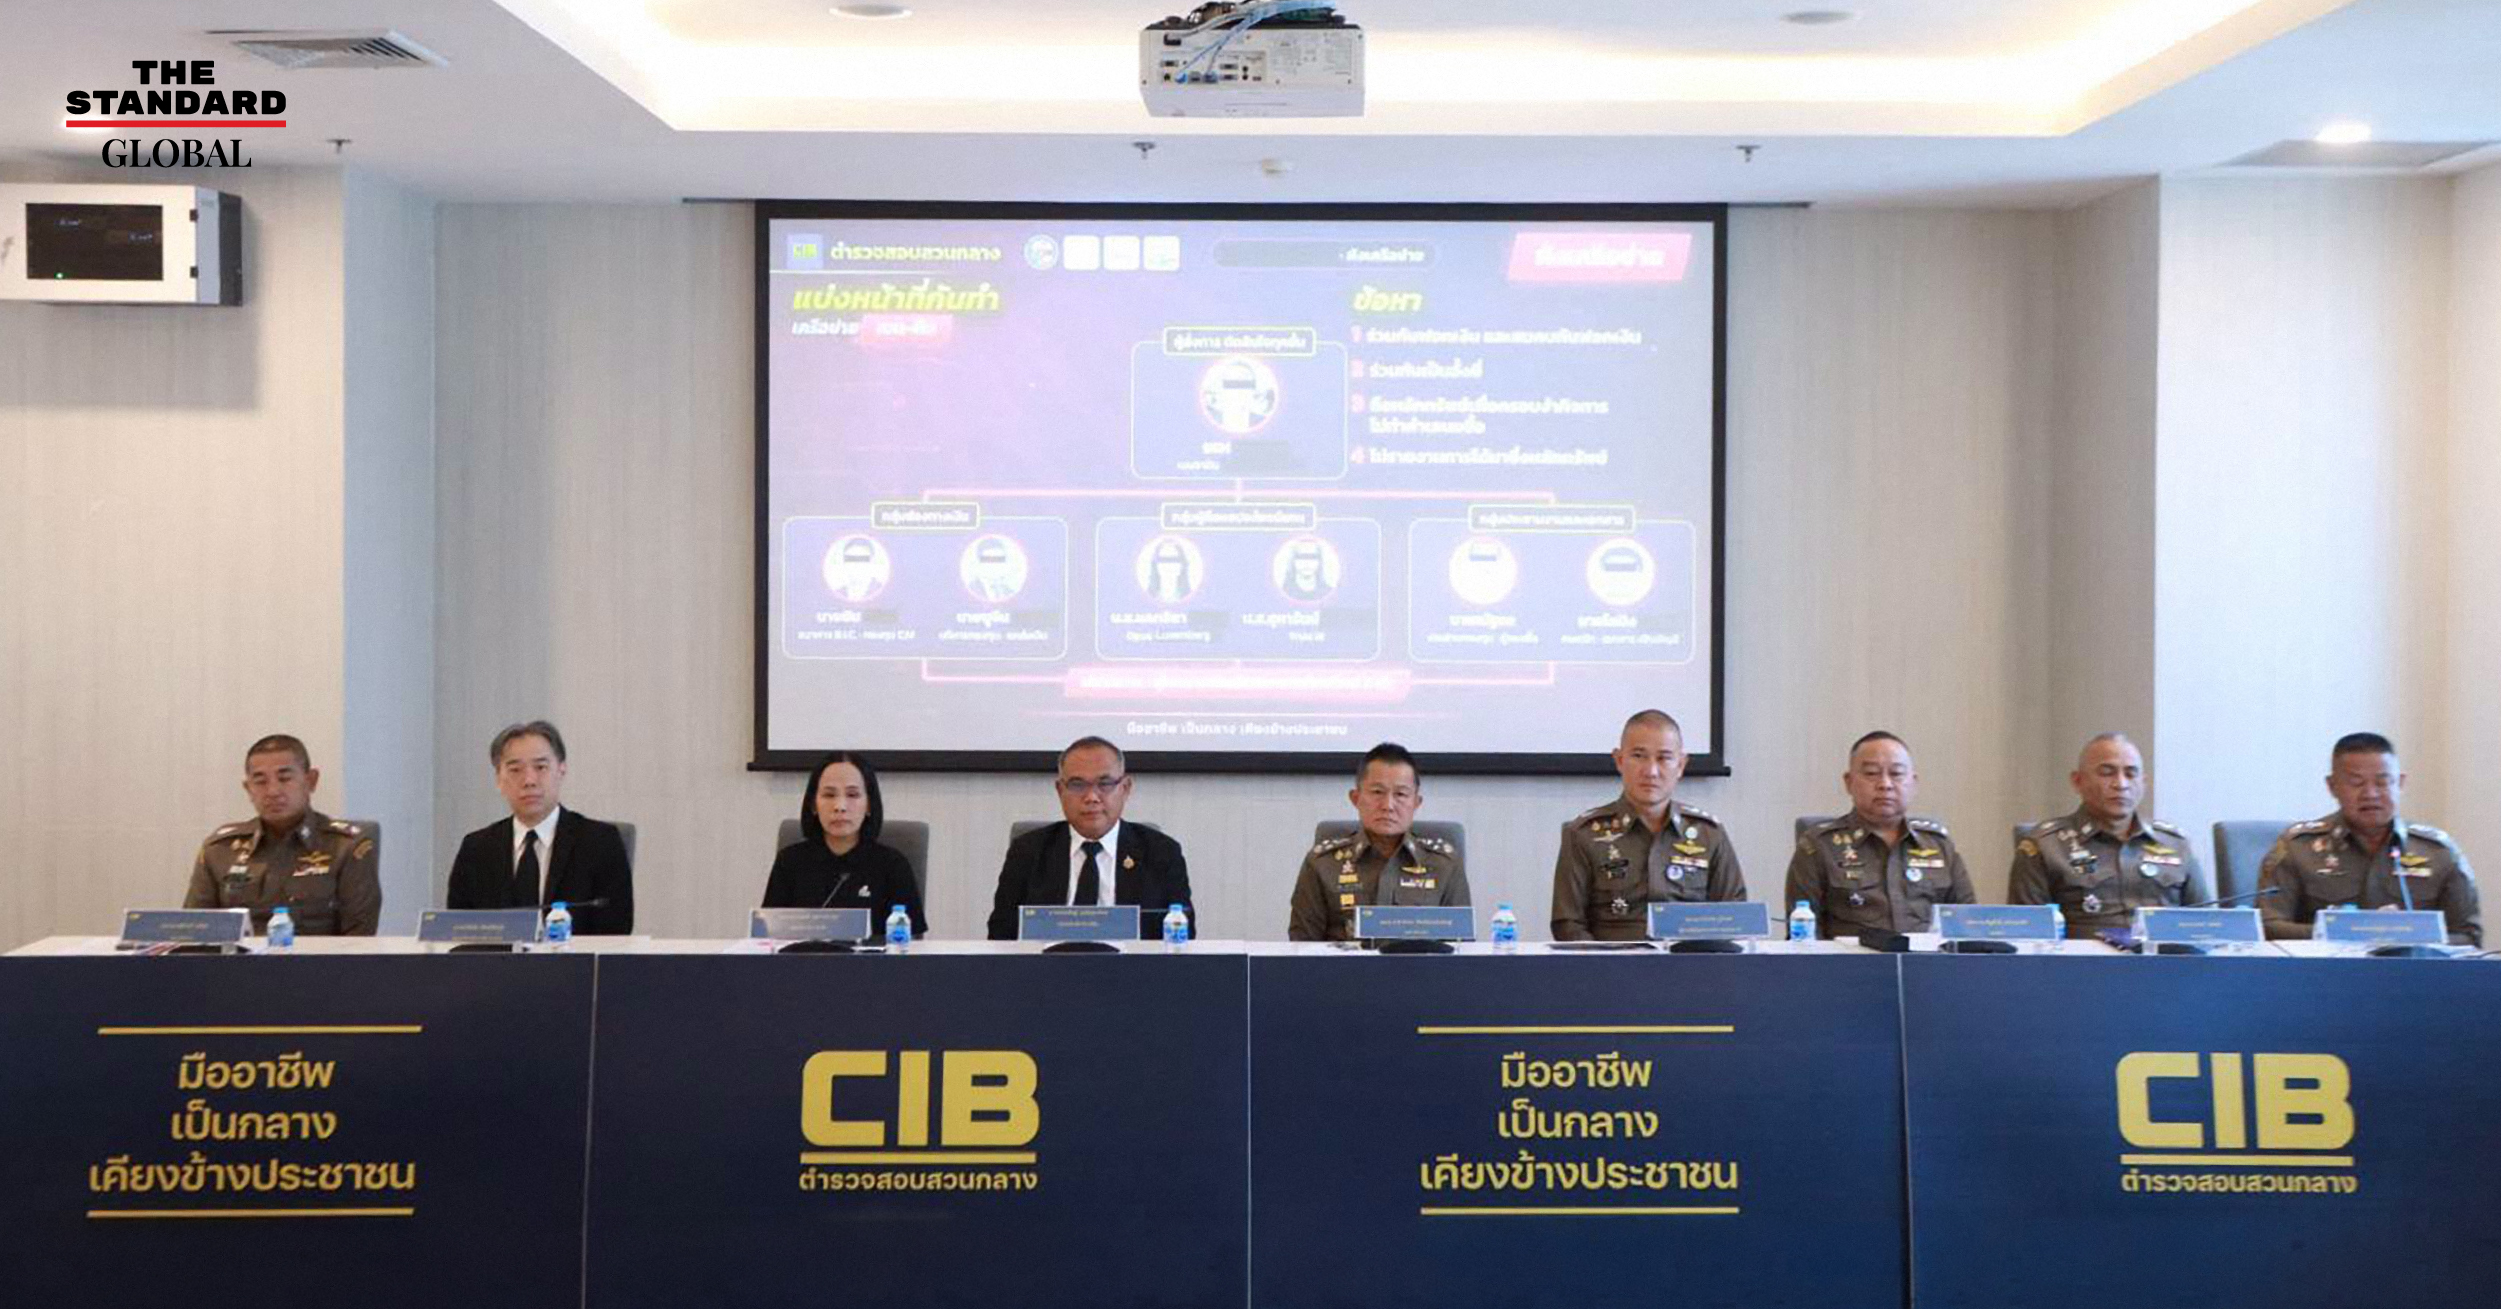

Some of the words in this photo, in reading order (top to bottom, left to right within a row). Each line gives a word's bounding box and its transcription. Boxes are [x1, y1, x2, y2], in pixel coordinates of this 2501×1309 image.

[830, 241, 1002, 261] ตำรวจสอบสวนกลาง
[1353, 284, 1423, 312] ข้อหา
[178, 1051, 335, 1090] มืออาชีพ
[1501, 1051, 1652, 1088] มืออาชีพ
[801, 1050, 1039, 1146] CIB
[2116, 1051, 2355, 1149] CIB
[171, 1098, 336, 1140] เป็นกลาง
[1498, 1098, 1658, 1138] เป็นกลาง
[89, 1151, 415, 1192] เคียงข้างประชาชน
[800, 1167, 1037, 1190] ตำรวจสอบสวนกลาง
[1420, 1149, 1738, 1190] เคียงข้างประชาชน
[2121, 1169, 2357, 1193] ตำรวจสอบสวนกลาง
